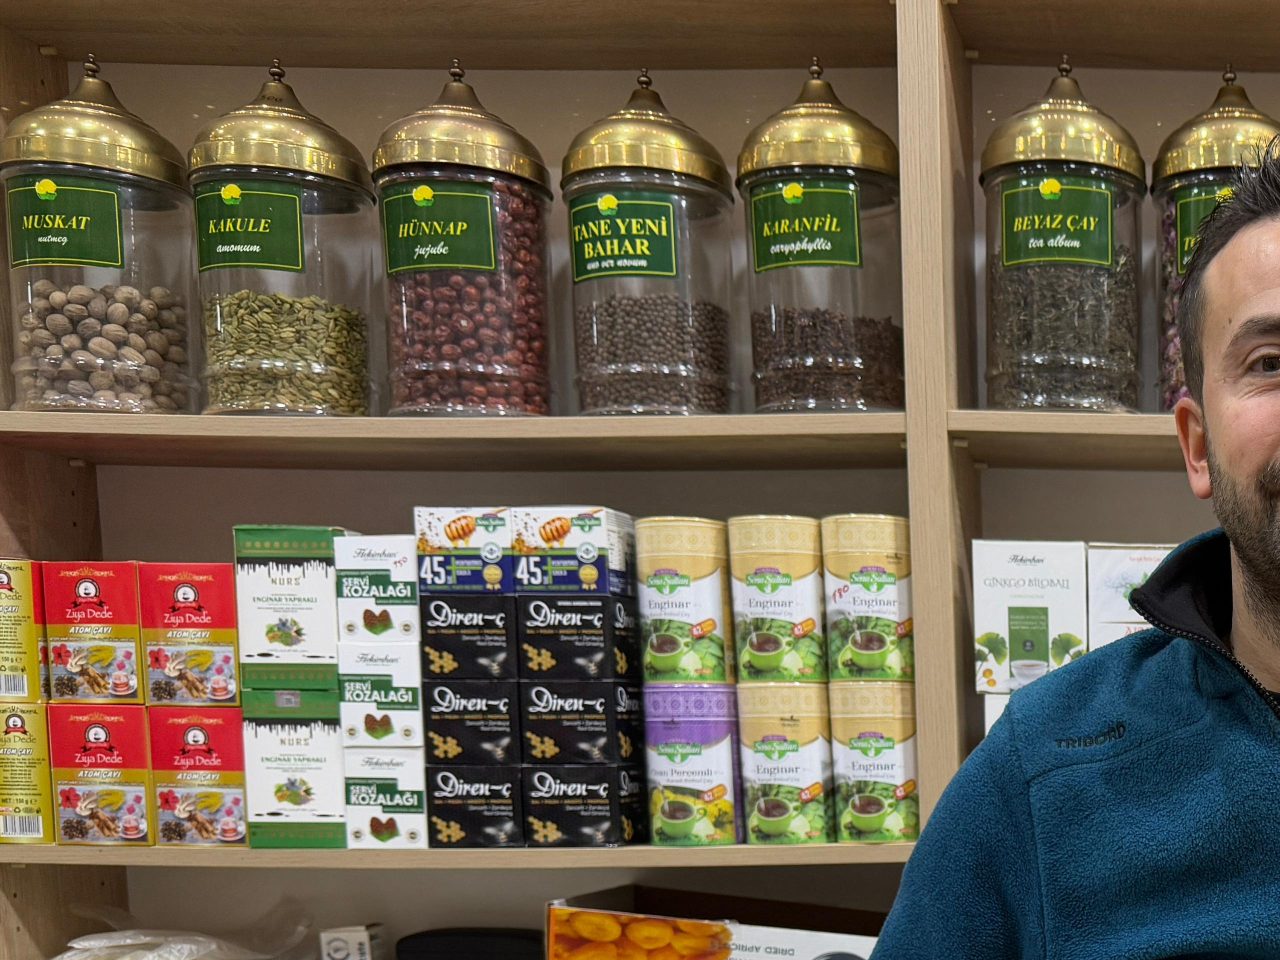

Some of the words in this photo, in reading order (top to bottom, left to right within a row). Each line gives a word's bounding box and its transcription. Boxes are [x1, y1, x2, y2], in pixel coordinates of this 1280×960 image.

[22, 213, 90, 230] MUSKAT
[209, 217, 271, 234] KAKULE
[399, 218, 468, 238] HÜNNAP
[574, 219, 612, 241] TANE
[615, 215, 668, 237] YENİ
[763, 213, 841, 237] KARANFİL
[1014, 214, 1063, 232] BEYAZ
[1066, 214, 1099, 232] ÇAY
[414, 240, 449, 259] jujube
[584, 238, 652, 259] BAHAR
[1029, 237, 1045, 249] tea
[1047, 235, 1082, 249] album
[420, 556, 446, 585] 45
[516, 556, 542, 585] 45
[343, 582, 412, 598] KOZALAĞI
[649, 599, 691, 611] Enginar
[750, 598, 794, 610] Enginar
[853, 596, 898, 608] Enginar
[66, 608, 85, 623] Ziya
[87, 606, 113, 619] Dede
[164, 613, 184, 627] Ziya
[185, 611, 212, 623] Dede
[426, 600, 506, 628] Diren-ç
[526, 600, 604, 628] Diren-ç
[69, 626, 91, 635] ATOM
[92, 626, 112, 636] ÇAYI
[166, 630, 189, 639] ATOM
[190, 630, 210, 640] ÇAYI
[345, 688, 413, 703] KOZALAĞI
[431, 686, 509, 713] Diren-ç
[528, 686, 606, 713] Diren-ç
[74, 753, 95, 767] Ziya
[97, 751, 123, 764] Dede
[173, 755, 194, 769] Ziya
[195, 753, 222, 766] Dede
[852, 761, 897, 773] Enginar
[78, 770, 100, 778] ATOM
[101, 770, 121, 779] ÇAYI
[200, 773, 220, 782] ÇAYI
[756, 764, 800, 776] Enginar
[434, 771, 511, 798] Diren-ç
[530, 771, 608, 798] Diren-ç
[351, 791, 418, 806] KOZALAĞI
